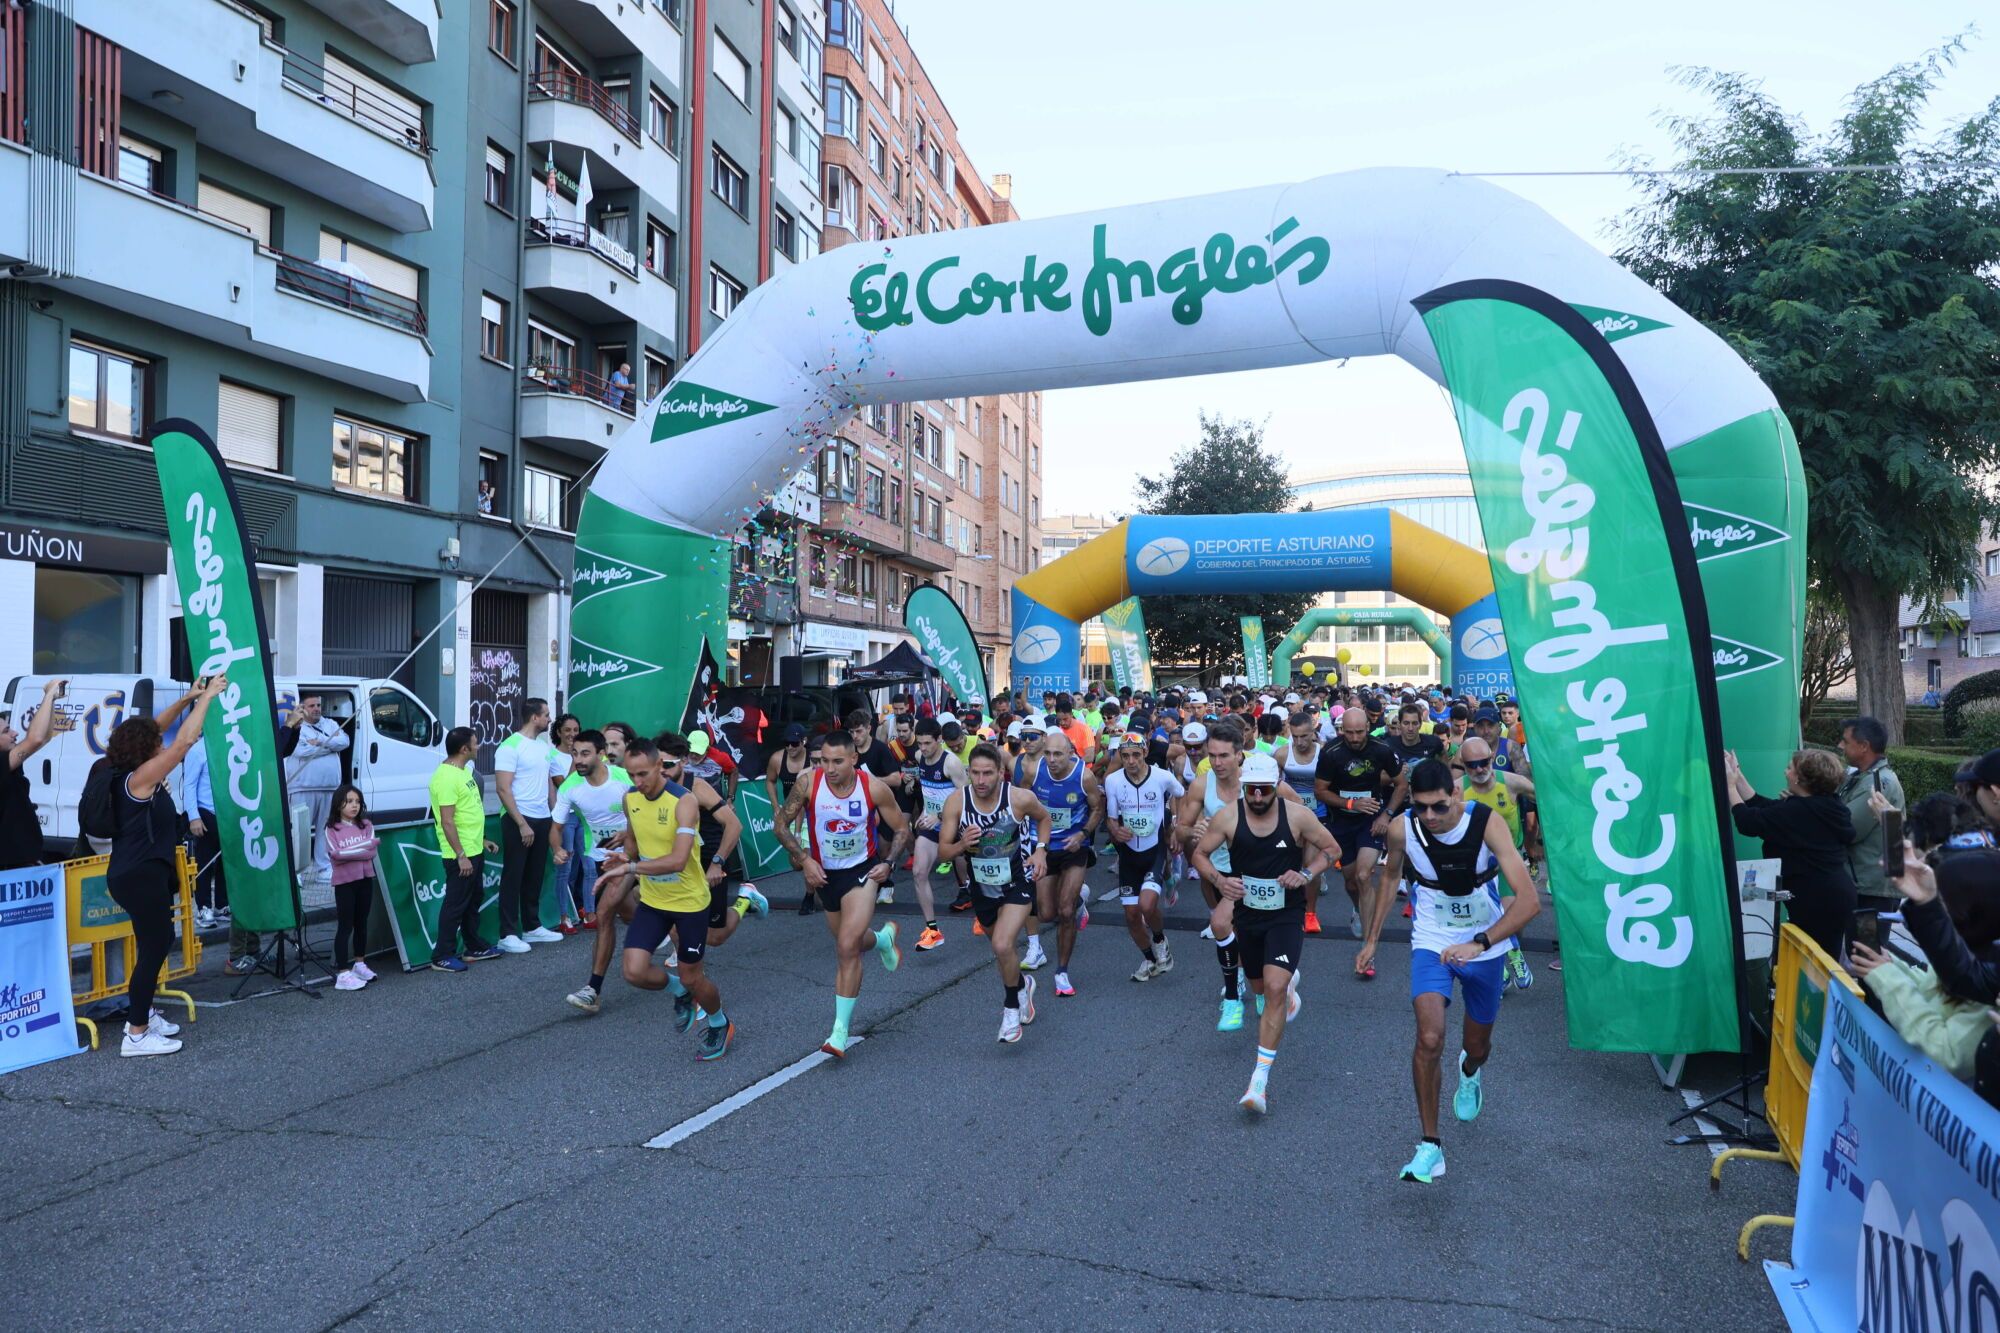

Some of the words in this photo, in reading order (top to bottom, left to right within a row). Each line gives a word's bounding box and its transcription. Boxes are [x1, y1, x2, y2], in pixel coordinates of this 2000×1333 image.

[849, 262, 913, 332] El
[915, 254, 1071, 325] Corte
[1082, 215, 1331, 337] Inglés
[1592, 314, 1639, 337] glés
[660, 400, 670, 415] El
[669, 398, 698, 414] Corte
[698, 393, 749, 419] Inglés
[1690, 516, 1756, 549] Inglés
[1195, 537, 1273, 555] DEPORTE
[1278, 533, 1375, 552] ASTURIANO
[1311, 556, 1323, 567] DE
[590, 561, 633, 585] Inglés
[1713, 648, 1749, 666] lés
[587, 653, 629, 678] Inglés
[1012, 674, 1071, 688] DEPORTE
[1458, 672, 1513, 685] DEPOR
[926, 801, 941, 811] 576
[1050, 812, 1064, 820] 87
[1128, 817, 1148, 828] 548
[832, 839, 856, 849] 514
[980, 864, 1001, 875] 481
[415, 881, 433, 903] El
[1250, 884, 1276, 898] 565
[1451, 902, 1471, 914] 81
[21, 990, 43, 1004] CLUB
[0, 1004, 39, 1023] EPORTIVO
[1859, 1030, 1917, 1114] MARATÓN
[1916, 1085, 1977, 1174] VERDE
